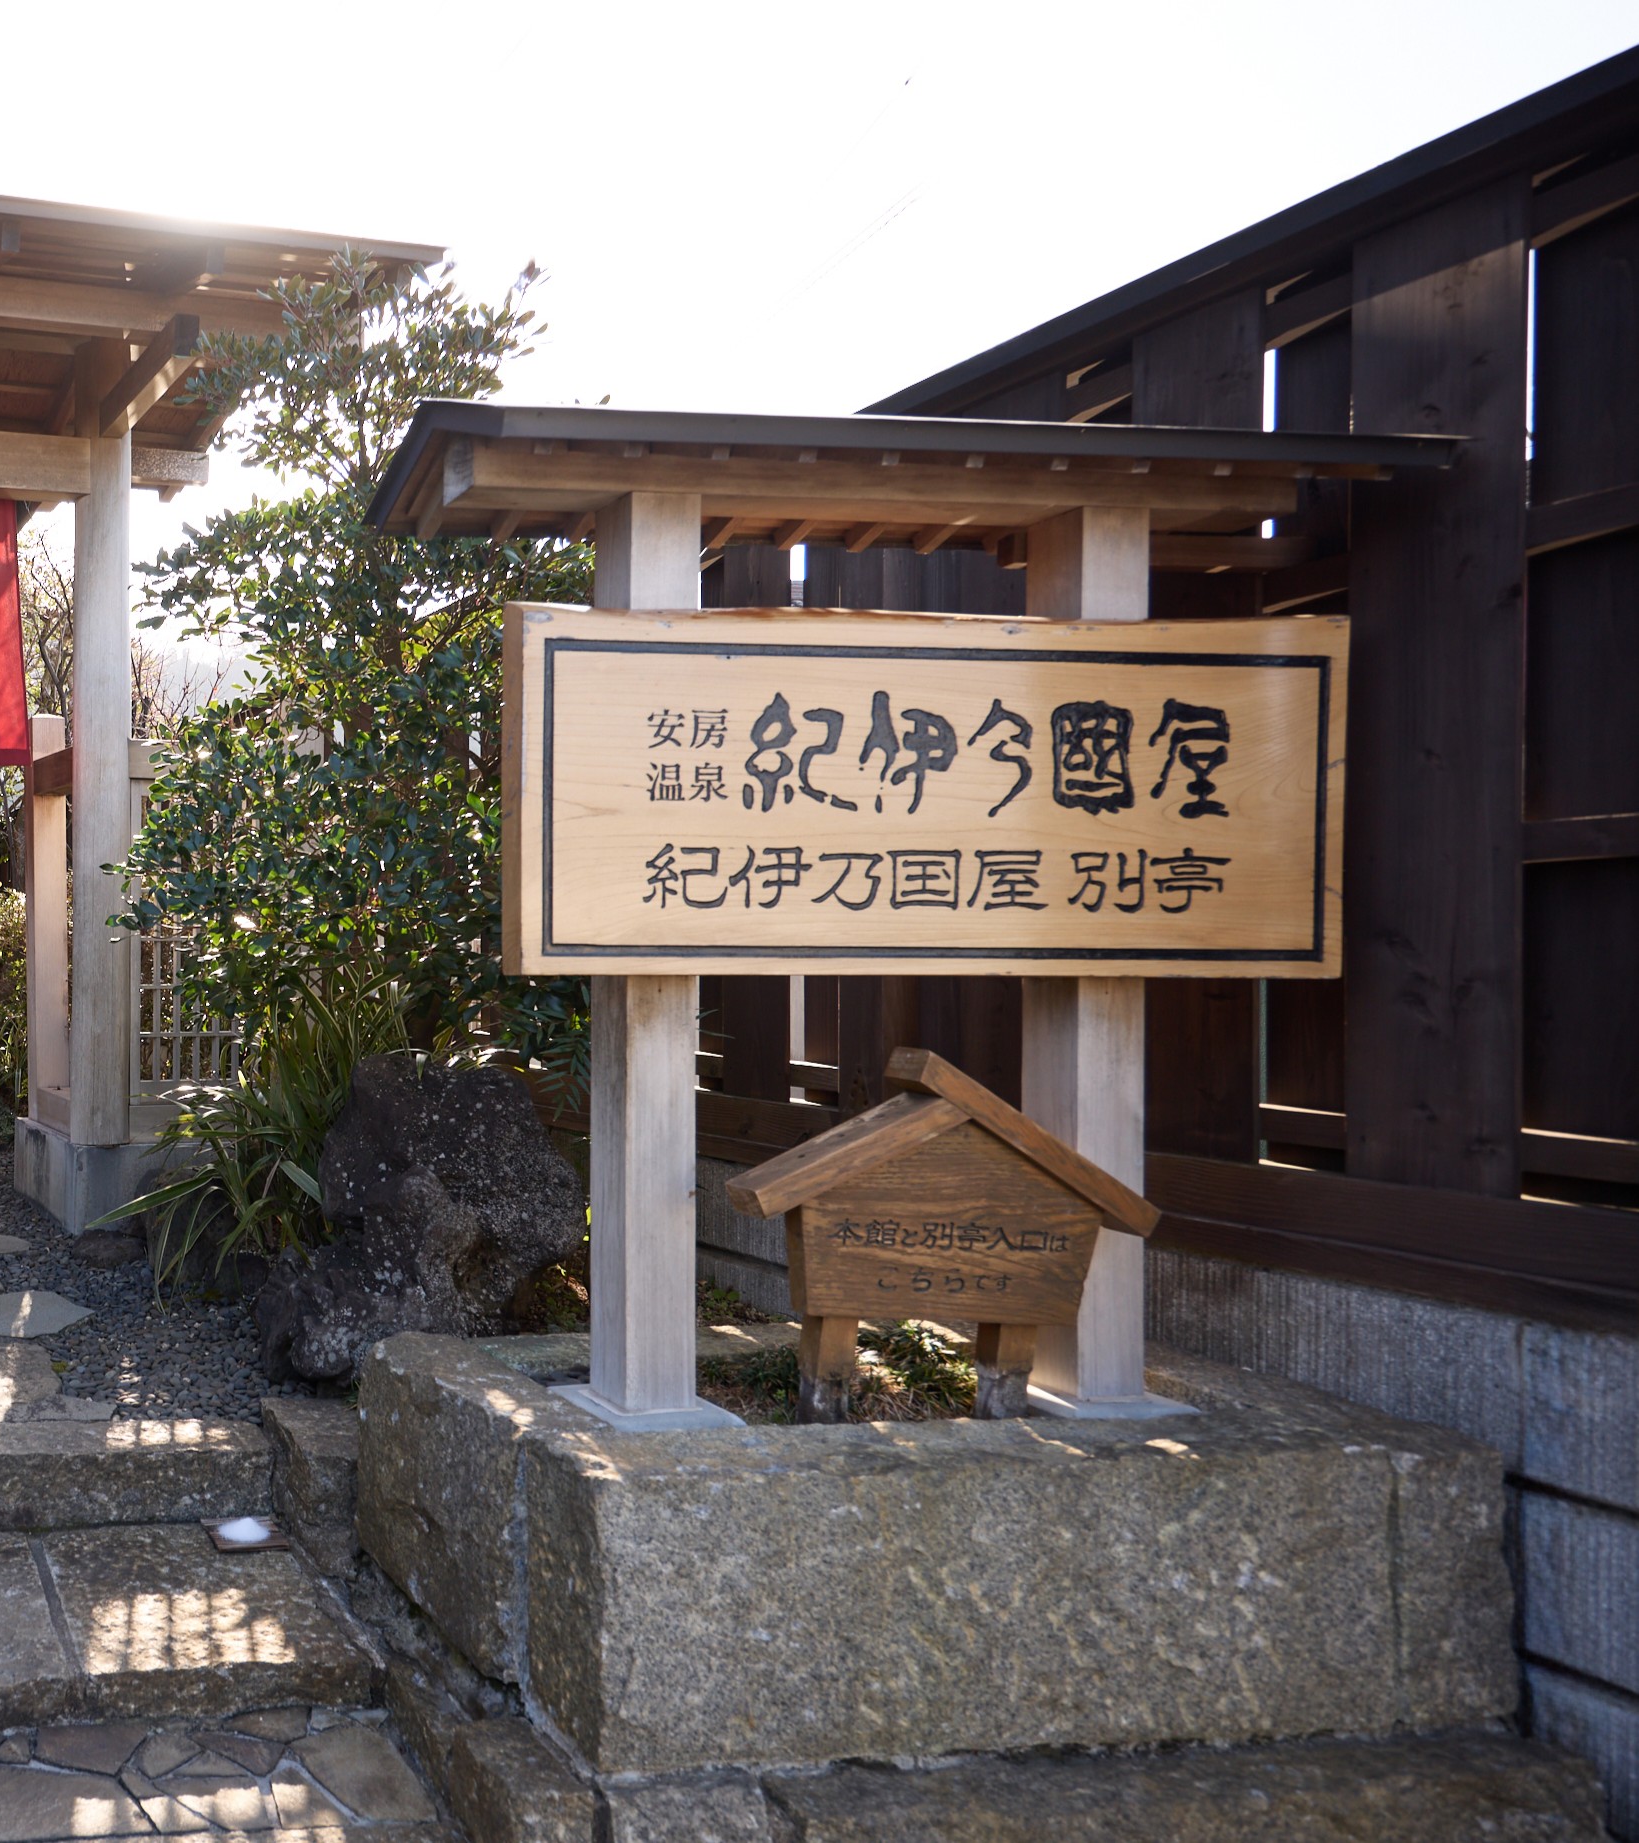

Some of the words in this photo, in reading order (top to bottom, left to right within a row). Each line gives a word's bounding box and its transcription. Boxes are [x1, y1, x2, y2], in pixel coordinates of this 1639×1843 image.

[647, 708, 729, 749] 安房
[646, 762, 729, 802] 温泉
[642, 843, 1050, 913] 紀伊乃国屋
[1068, 848, 1233, 914] 別亭
[828, 1218, 1070, 1254] 本館と別亭入口は
[877, 1266, 1013, 1293] こちらです
